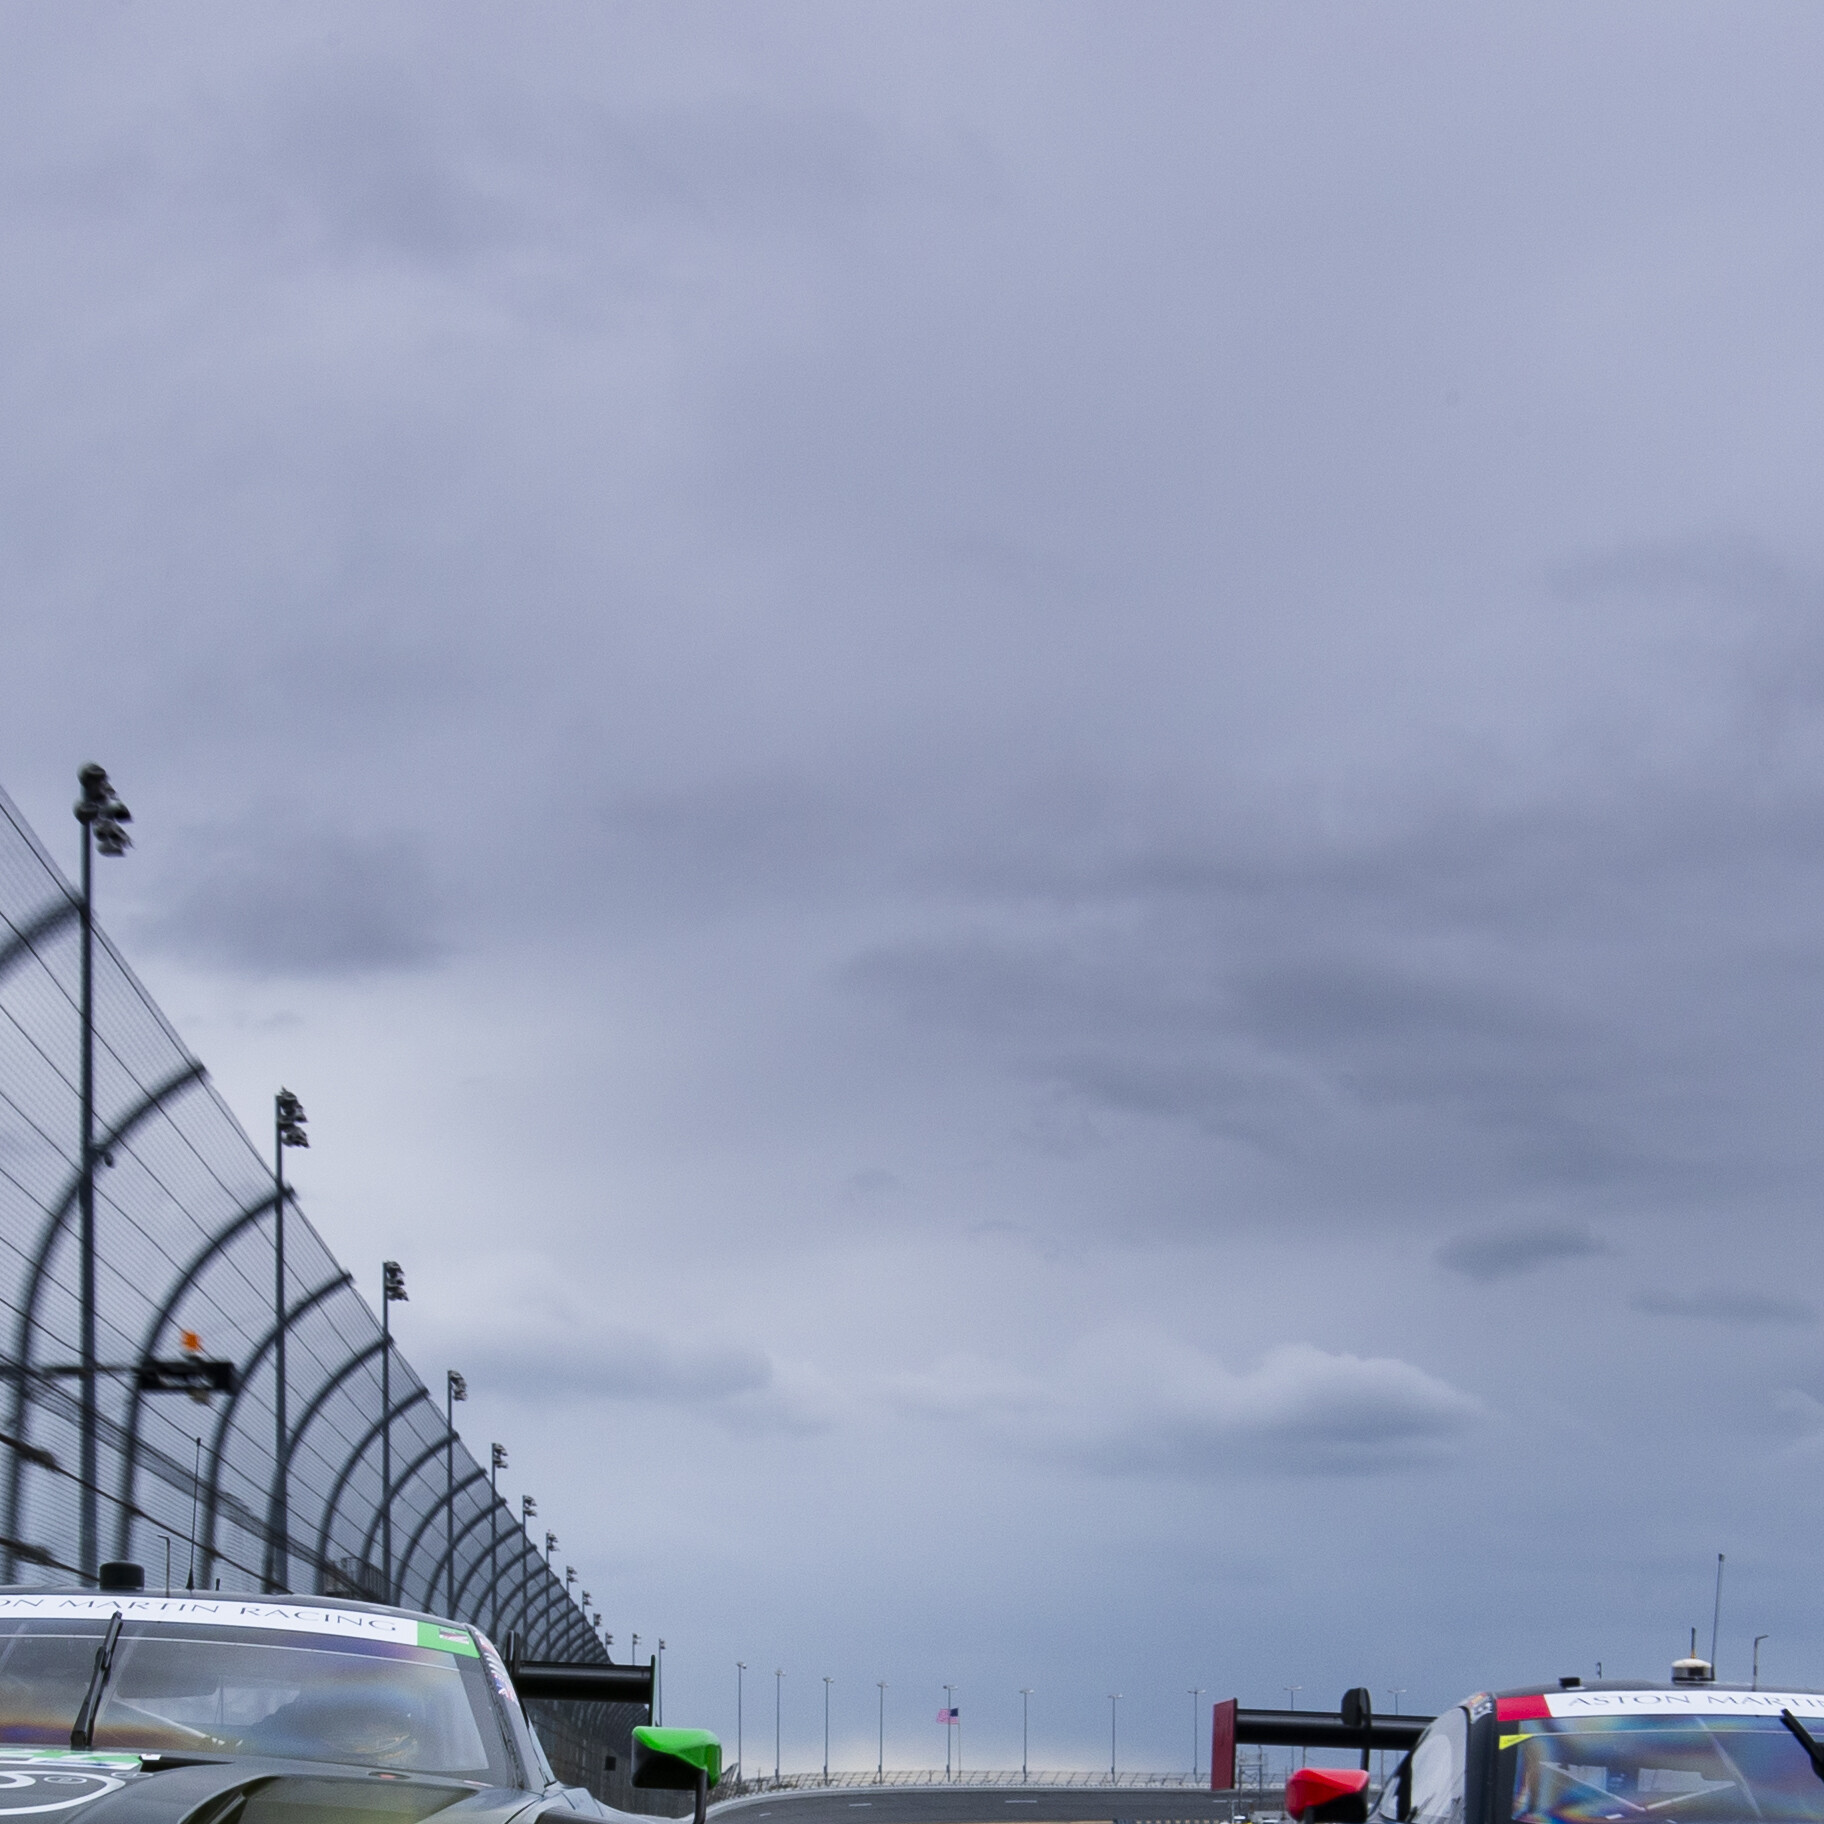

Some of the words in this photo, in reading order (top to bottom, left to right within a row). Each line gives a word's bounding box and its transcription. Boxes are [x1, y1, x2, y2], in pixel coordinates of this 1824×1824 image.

[57, 1599, 219, 1613] MARTIN
[239, 1606, 397, 1631] RACING
[1567, 1694, 1691, 1707] ASTON
